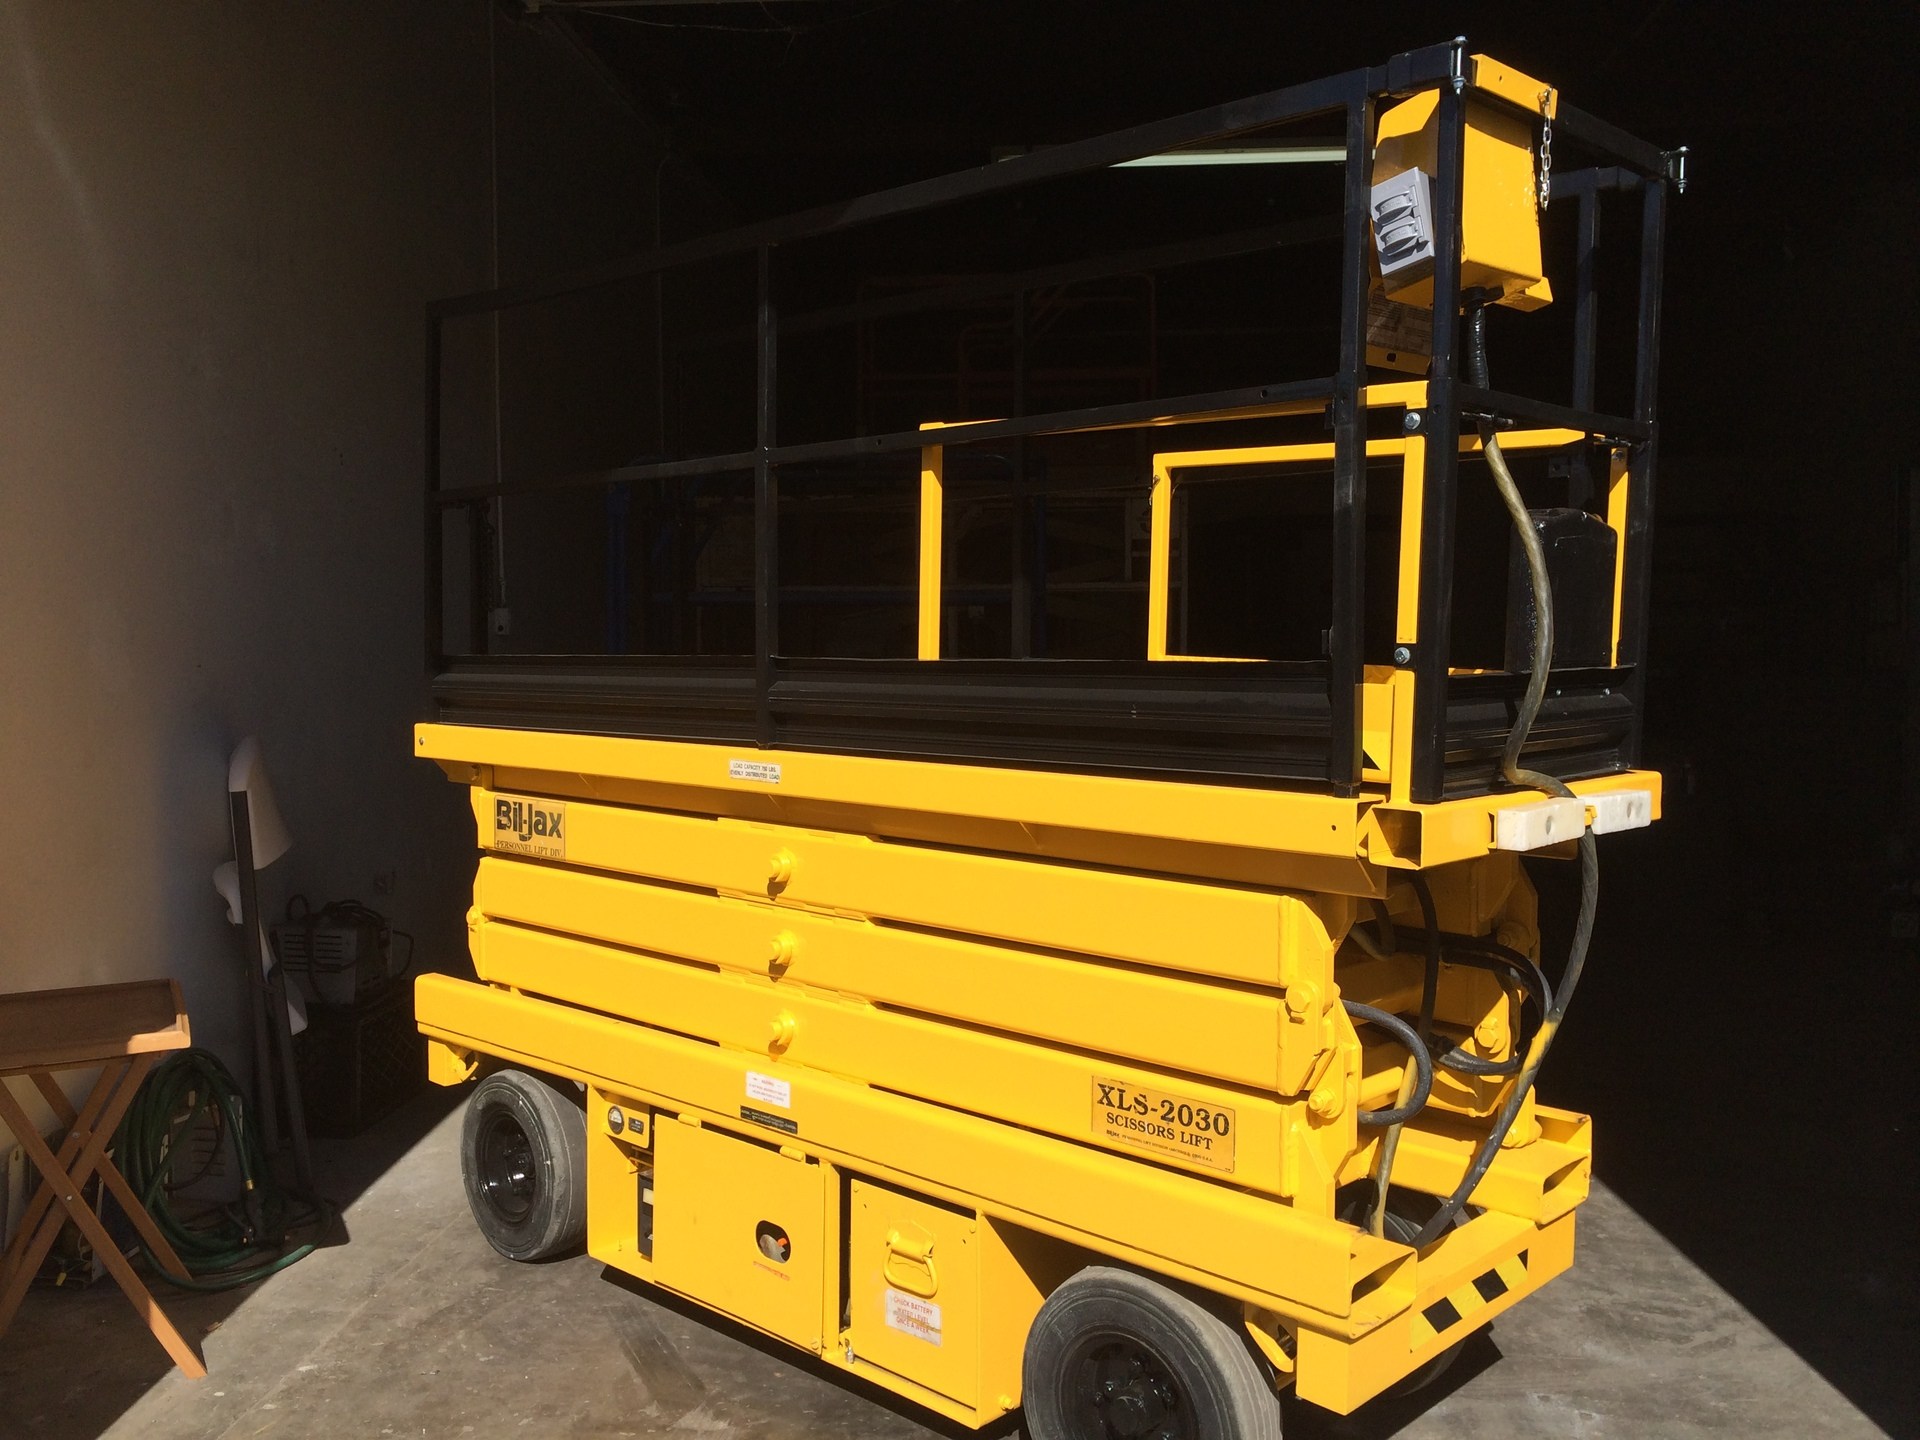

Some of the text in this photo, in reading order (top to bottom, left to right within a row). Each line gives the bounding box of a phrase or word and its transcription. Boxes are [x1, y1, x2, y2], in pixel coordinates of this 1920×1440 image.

[496, 840, 533, 853] PERSONNEL
[534, 845, 548, 856] LIFT
[1096, 1083, 1230, 1137] XLS-2030
[1106, 1112, 1175, 1140] SCISSORS
[1180, 1131, 1213, 1150] LIFT
[894, 1296, 933, 1316] CHECK BATTERY
[896, 1316, 910, 1327] ONCE
